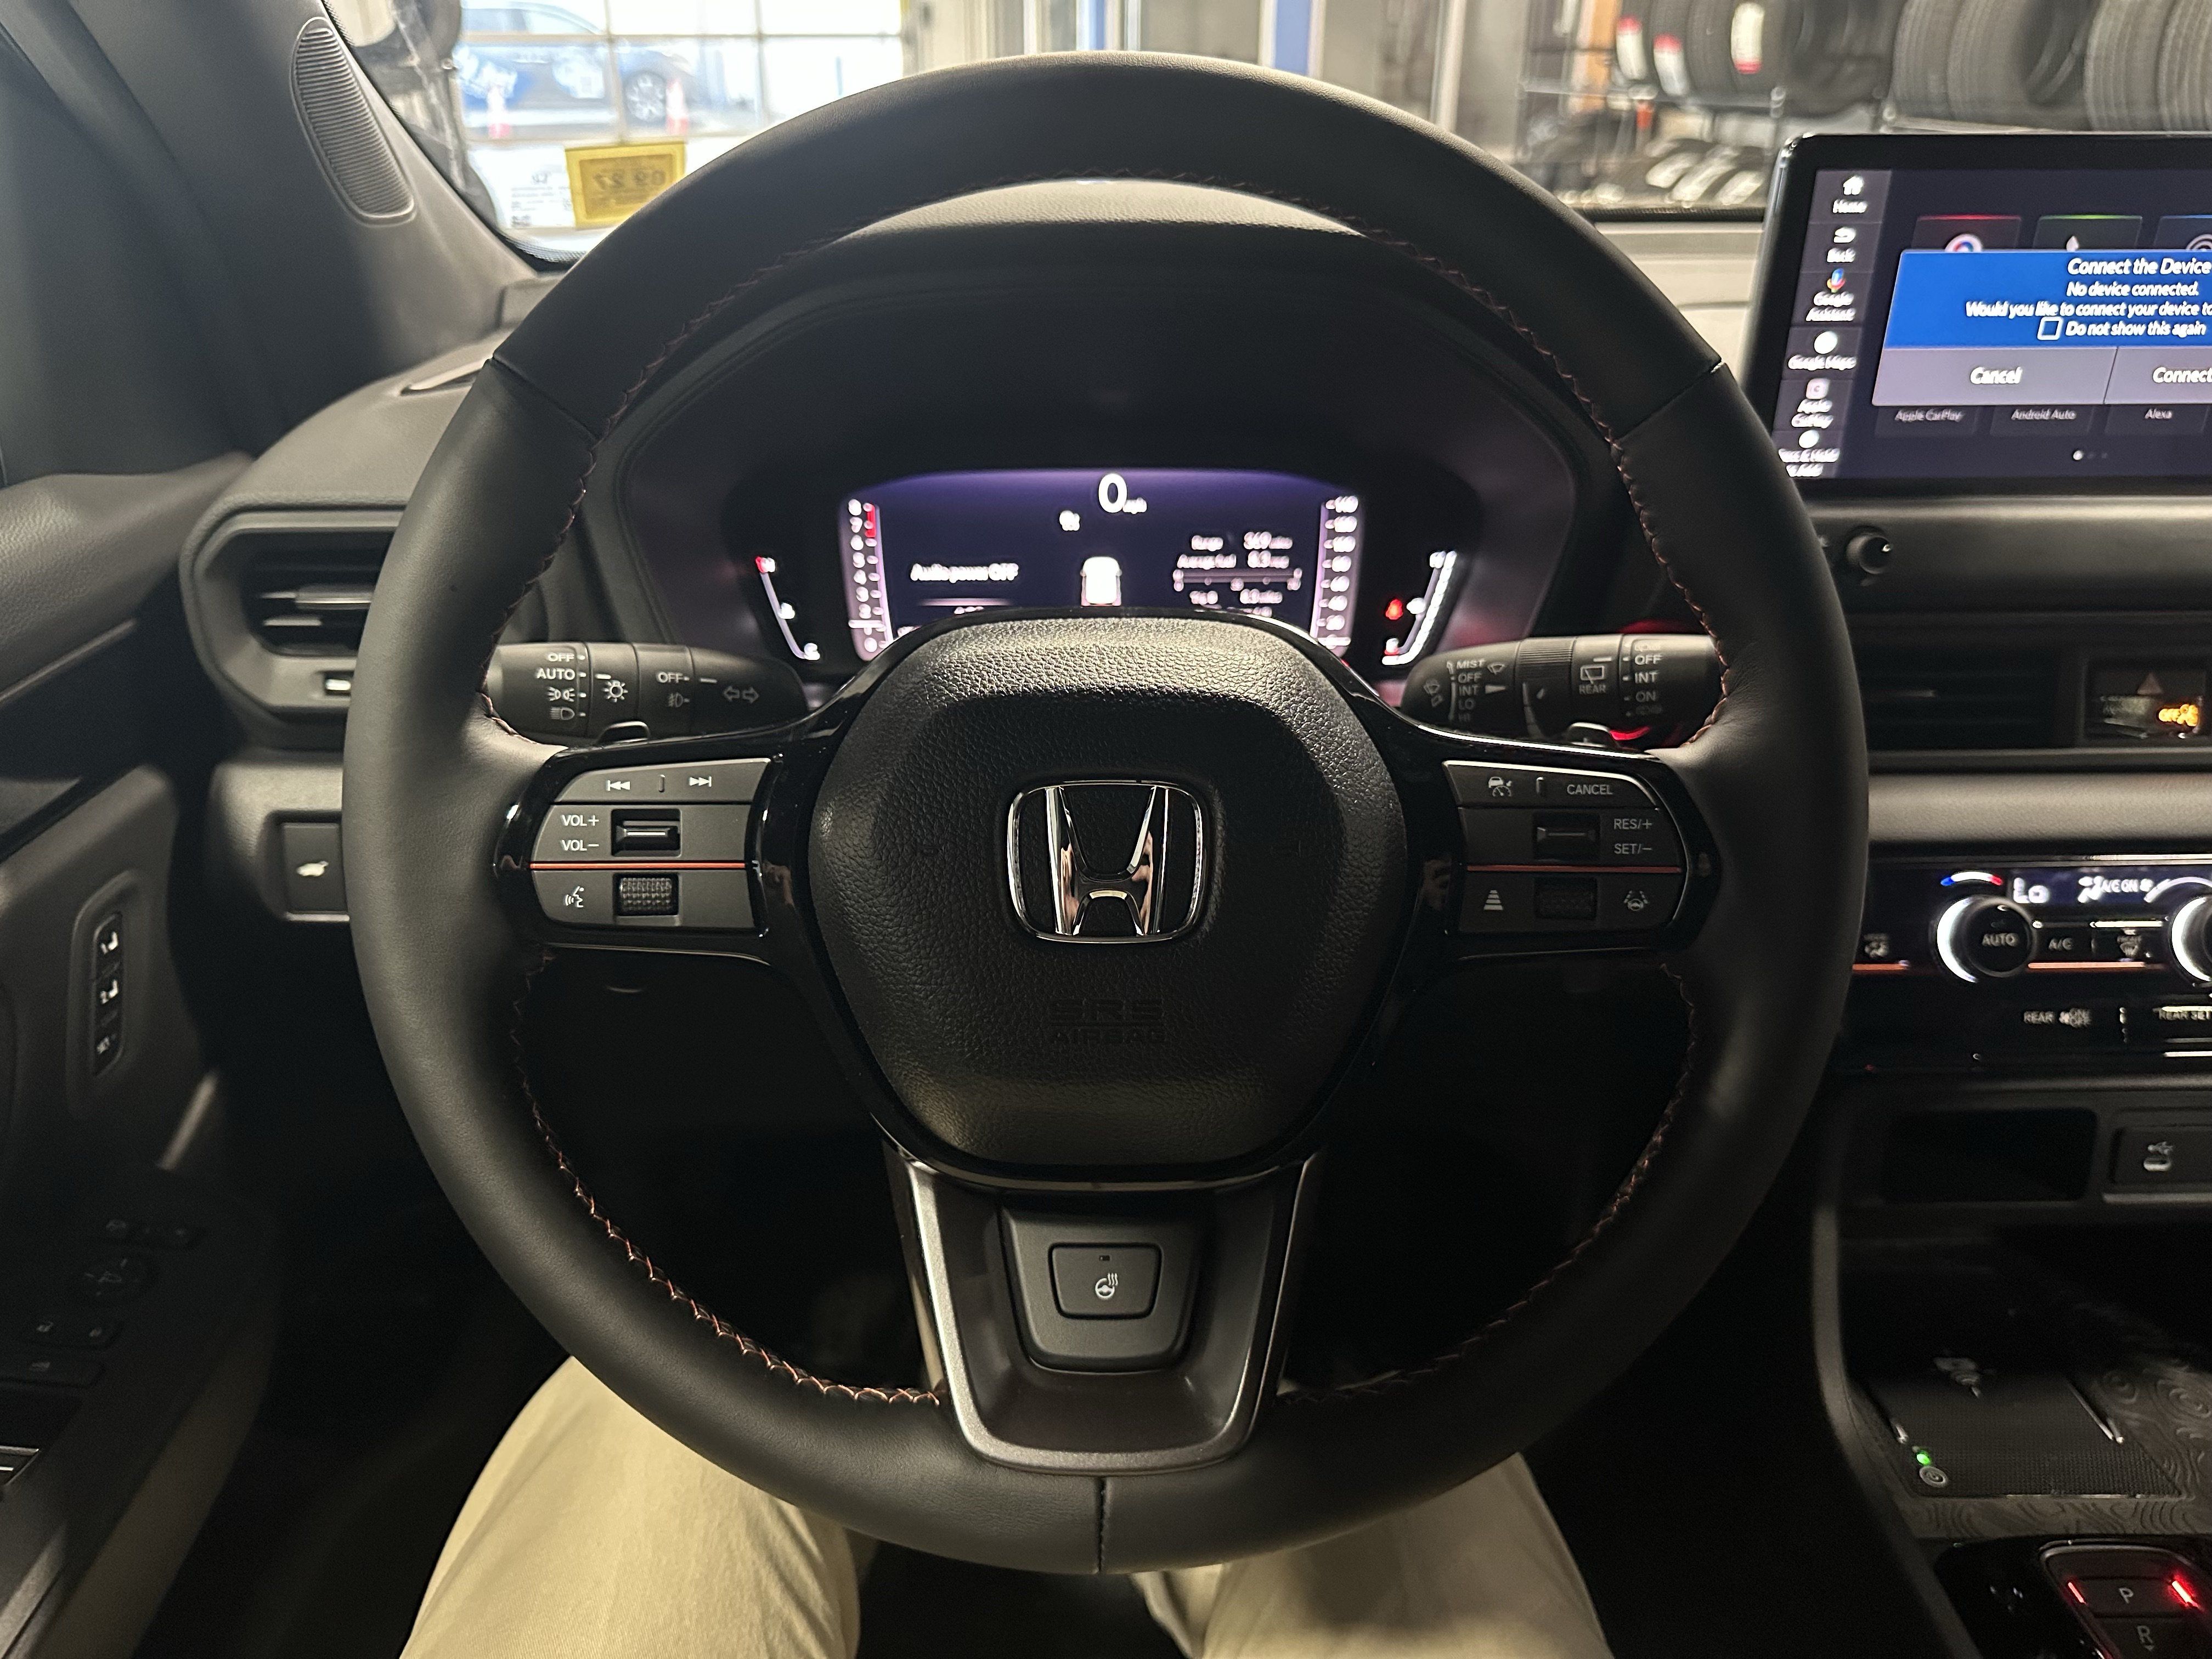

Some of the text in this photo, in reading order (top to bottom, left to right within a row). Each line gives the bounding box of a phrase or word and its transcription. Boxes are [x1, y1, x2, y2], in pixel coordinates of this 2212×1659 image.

[2067, 258, 2212, 275] Connect the Device
[2067, 281, 2199, 297] No device connected.
[1966, 301, 2008, 317] Would
[2008, 303, 2035, 319] you
[2035, 301, 2059, 317] like
[2059, 302, 2074, 317] to
[2075, 302, 2126, 317] connect
[2127, 303, 2158, 318] your
[2158, 302, 2200, 316] device
[2066, 321, 2207, 338] Do not show this again
[1970, 367, 2023, 385] Cancel
[2152, 367, 2212, 383] Connect
[1894, 409, 1966, 422] Apple CarPlay
[2011, 409, 2077, 421] Android Auto
[2145, 409, 2172, 420] Alexa
[1098, 472, 1127, 514] 0
[548, 653, 575, 662] OFF
[1634, 654, 1663, 665] OFF
[1457, 659, 1486, 669] MIST
[535, 668, 575, 680] AUTO
[658, 673, 684, 684] OFF
[1458, 673, 1482, 684] OFF
[1634, 670, 1660, 684] INT
[1459, 685, 1481, 696] INT
[1579, 685, 1607, 695] REAR
[1635, 691, 1656, 702] ON
[1458, 698, 1475, 710] LO
[1566, 785, 1613, 796] CANCEL
[561, 815, 600, 827] VOL+
[1613, 819, 1653, 830] RES/+
[1982, 933, 2019, 947] AUTO
[2048, 938, 2074, 951] A/C
[1049, 999, 1164, 1021] SRS
[1049, 1028, 1165, 1044] AIRBAG
[2119, 1587, 2134, 1604] P
[2137, 1625, 2153, 1643] R
